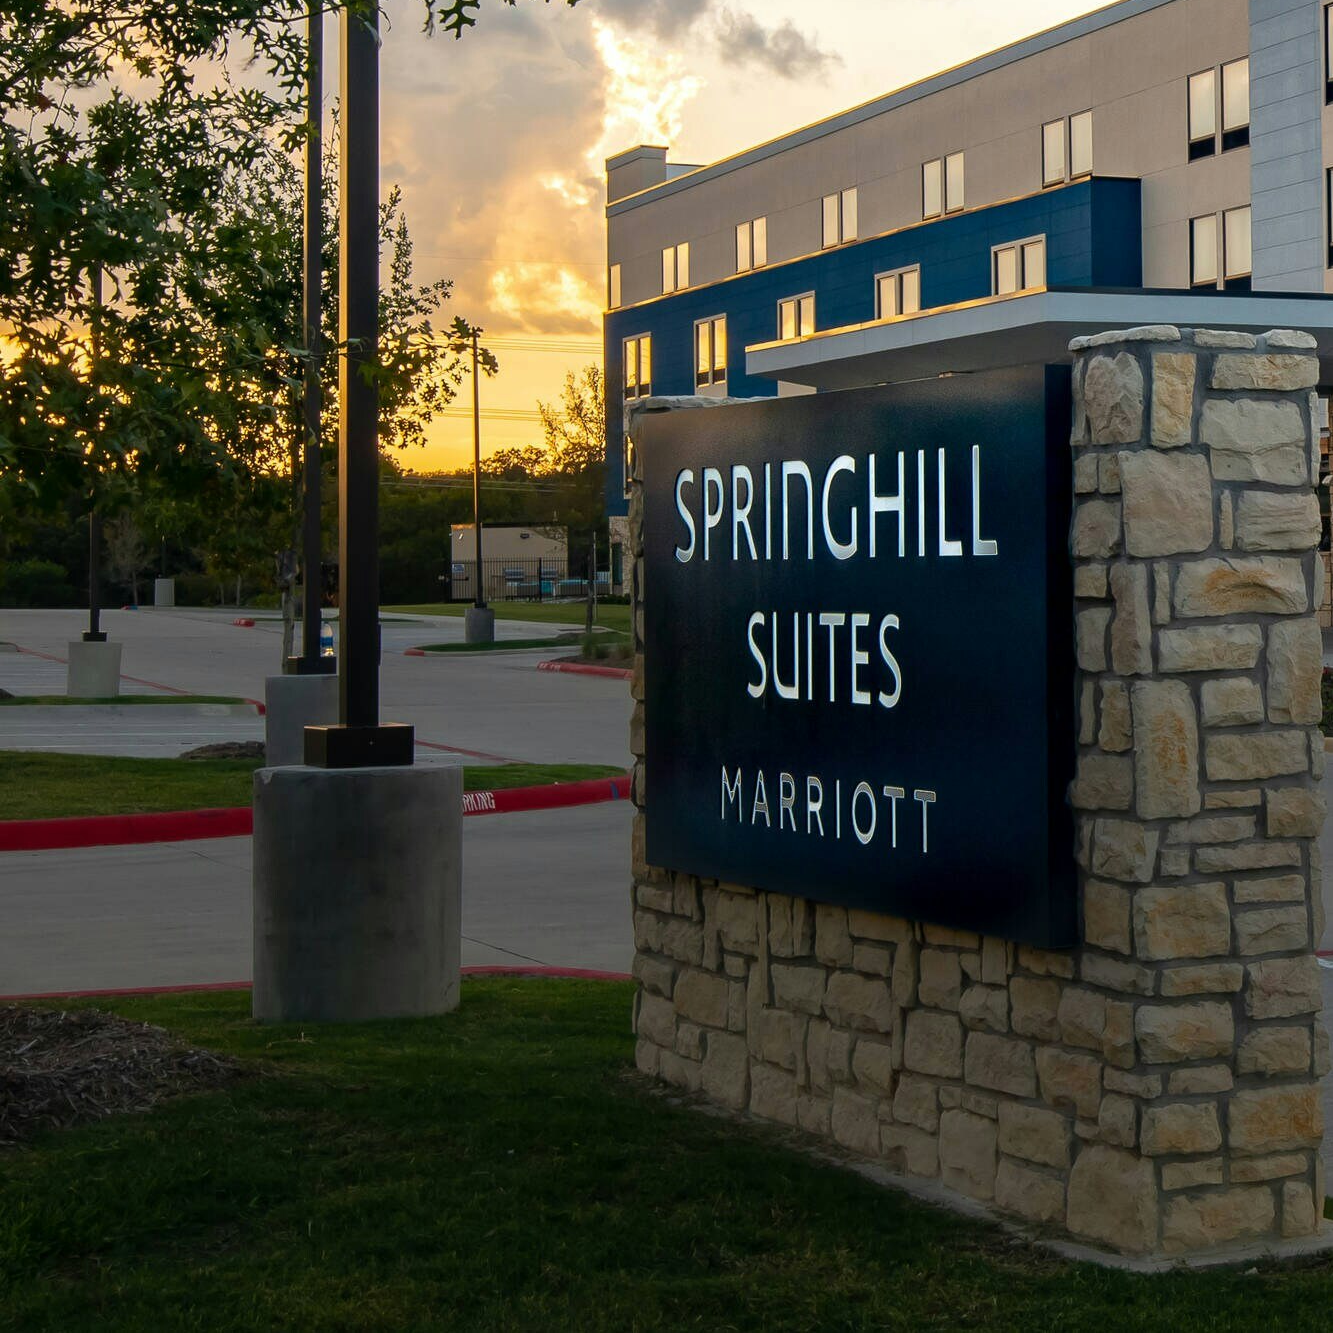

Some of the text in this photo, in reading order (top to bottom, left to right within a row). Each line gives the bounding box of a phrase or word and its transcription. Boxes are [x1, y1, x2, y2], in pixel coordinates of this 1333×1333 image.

[674, 444, 998, 563] SPRINGHILL
[747, 611, 902, 709] SUITES
[463, 792, 496, 812] RKING
[721, 765, 937, 854] MARRIOTT
